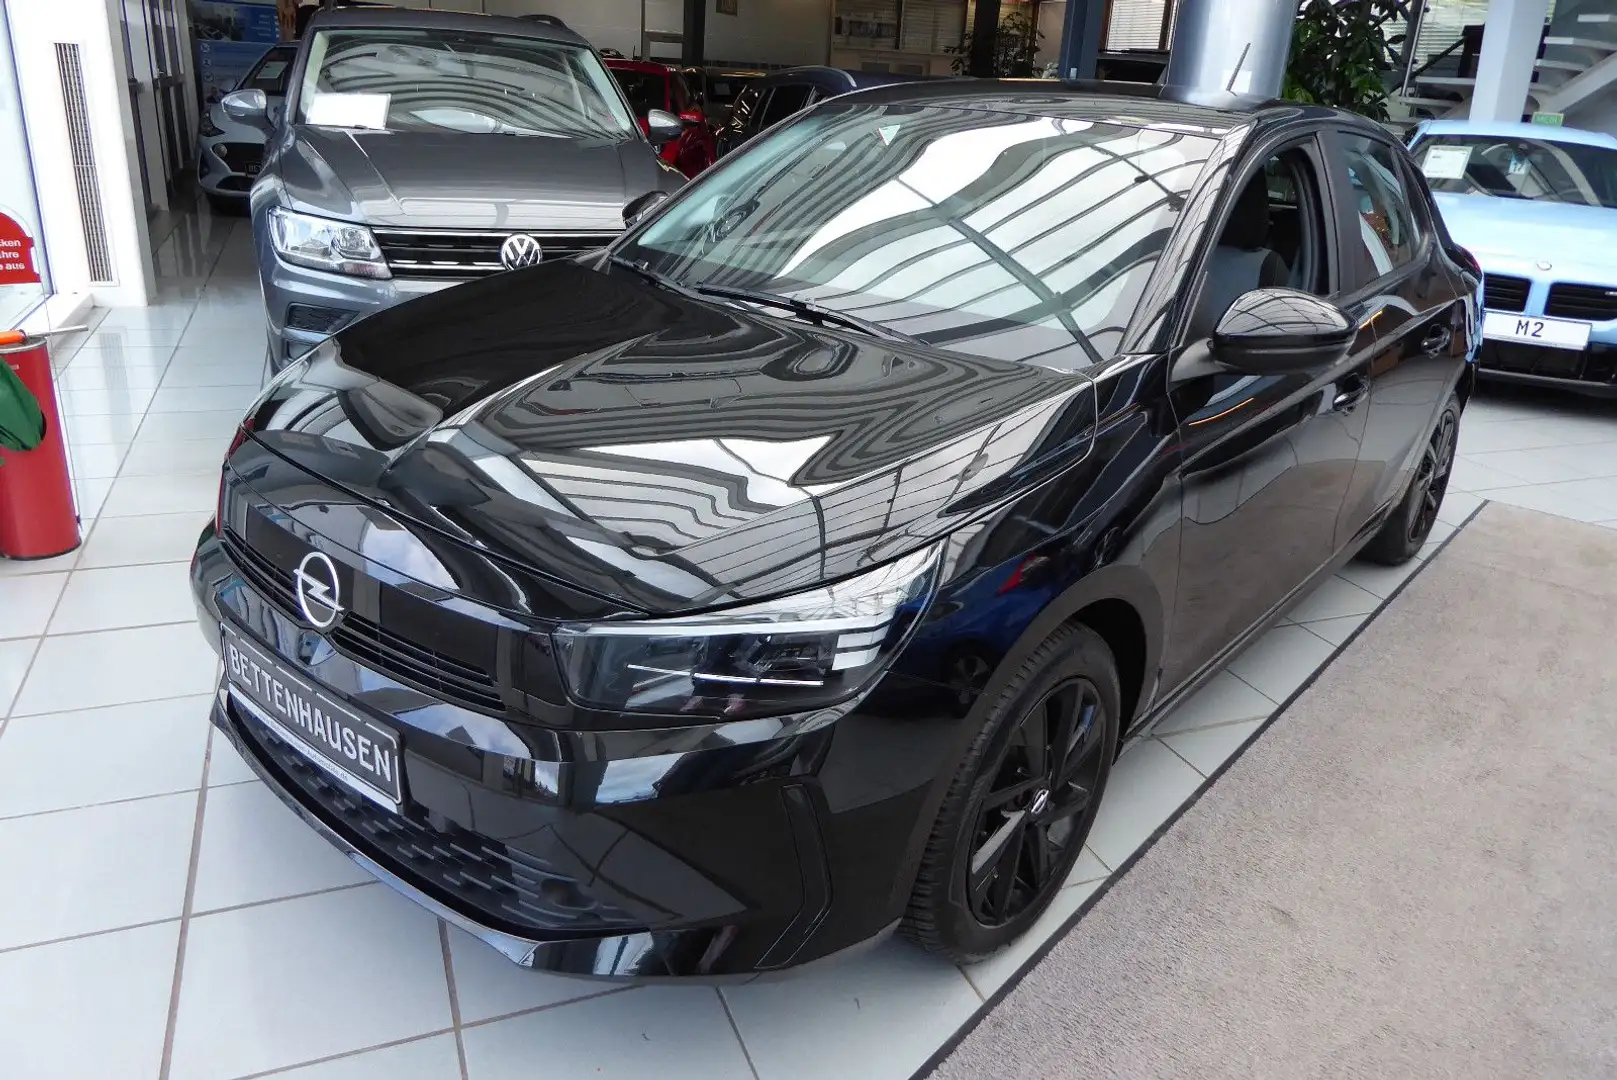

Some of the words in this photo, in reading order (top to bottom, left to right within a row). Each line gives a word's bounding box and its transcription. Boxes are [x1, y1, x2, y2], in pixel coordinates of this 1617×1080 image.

[0, 250, 19, 258] hre
[5, 262, 25, 270] aus
[228, 642, 392, 782] BETTENHAUSEN
